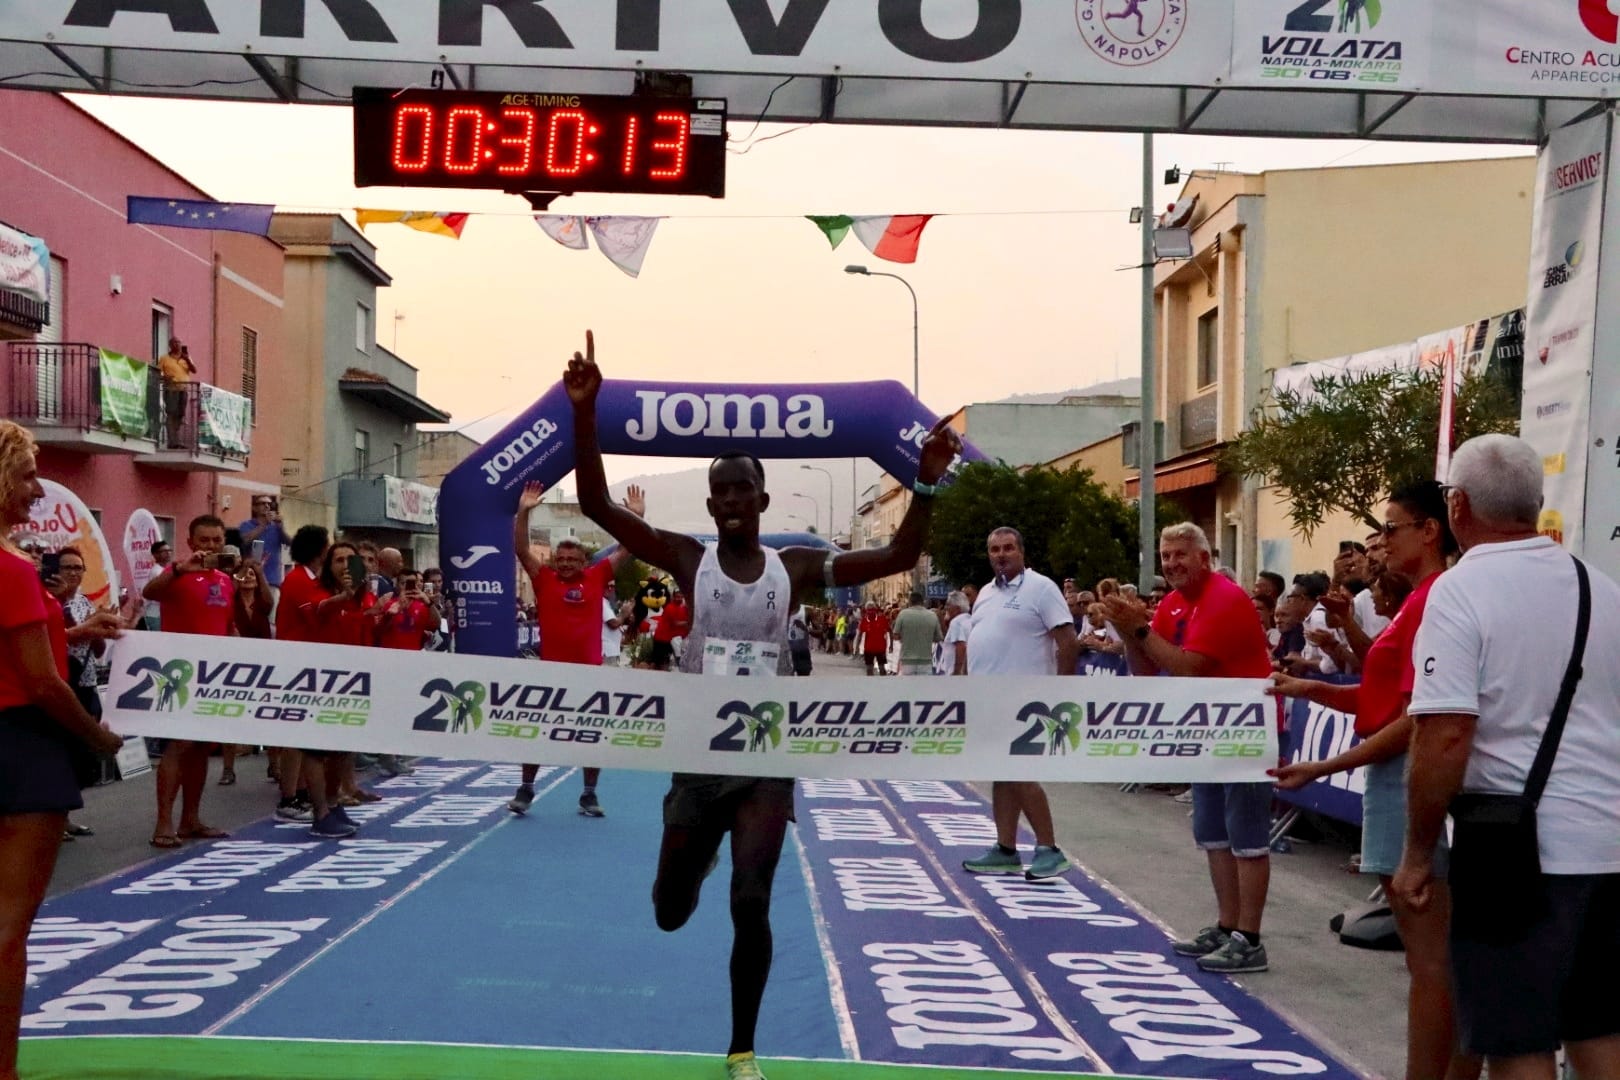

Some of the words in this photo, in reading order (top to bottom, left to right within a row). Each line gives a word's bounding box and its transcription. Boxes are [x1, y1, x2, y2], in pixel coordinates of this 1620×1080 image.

[1094, 34, 1167, 60] NAPOLA
[1262, 36, 1402, 60] VOLATA
[1505, 46, 1575, 66] CENTRO
[1260, 57, 1402, 71] NAPOLA-MOKARTA
[394, 106, 688, 178] 00:30:13
[196, 660, 371, 696] VOLATA
[194, 687, 371, 710] NAPOLA-MOKARTA
[489, 682, 666, 719] VOLATA
[488, 709, 666, 732] NAPOLA-MOKARTA
[787, 701, 967, 725] VOLATA
[1086, 702, 1266, 727] VOLATA
[786, 727, 967, 738] NAPOLA-MOKARTA
[1085, 729, 1267, 740] NAPOLA-MOKARTA
